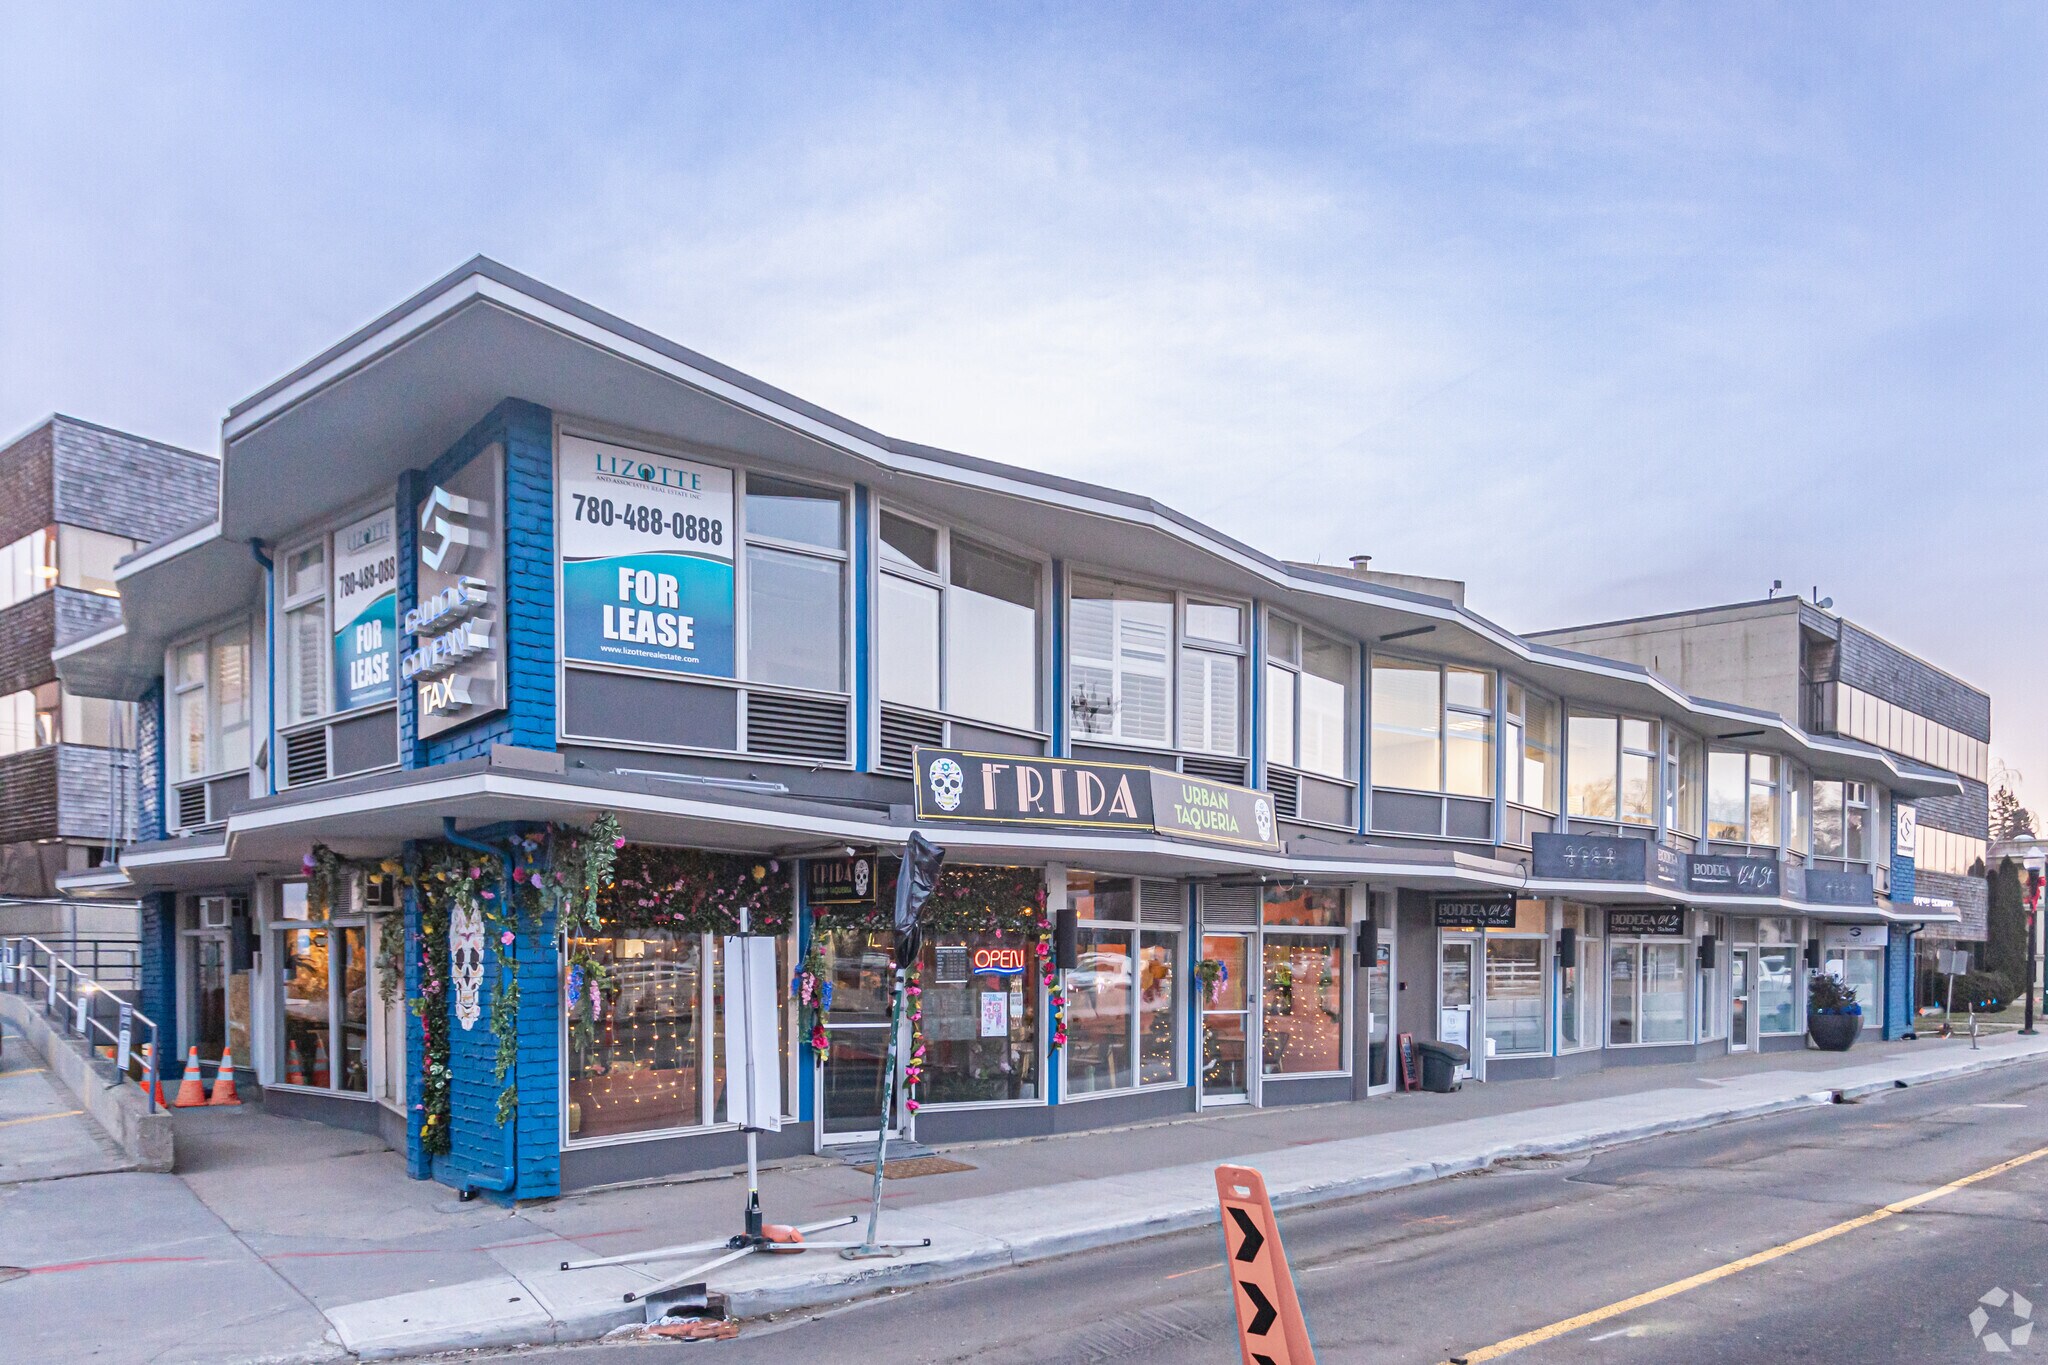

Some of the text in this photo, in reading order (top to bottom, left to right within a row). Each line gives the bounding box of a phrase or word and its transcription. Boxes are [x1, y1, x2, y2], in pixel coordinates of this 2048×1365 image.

[595, 474, 612, 484] AND
[612, 478, 650, 490] ASSOCIATES
[596, 453, 702, 491] LIZOTTE
[572, 493, 723, 546] 780-488-0888
[618, 566, 680, 609] FOR
[356, 619, 383, 655] FOR
[602, 604, 696, 650] LEASE
[402, 616, 490, 681] COMPANY
[600, 645, 700, 664] www.lizotterealestate.com
[350, 651, 390, 691] LEASE
[420, 673, 460, 716] TAX
[981, 763, 1138, 819] FRIDA
[1182, 783, 1229, 810] URBAN
[1174, 804, 1240, 833] TAQUERIA
[813, 862, 852, 883] FRIDA
[1693, 863, 1731, 877] BODEGA
[1737, 865, 1757, 885] 124
[1439, 903, 1486, 916] BODEGA
[1477, 917, 1485, 926] by
[1488, 917, 1508, 925] Sabor
[1611, 914, 1656, 925] BODEGA
[974, 948, 1025, 969] OPEN
